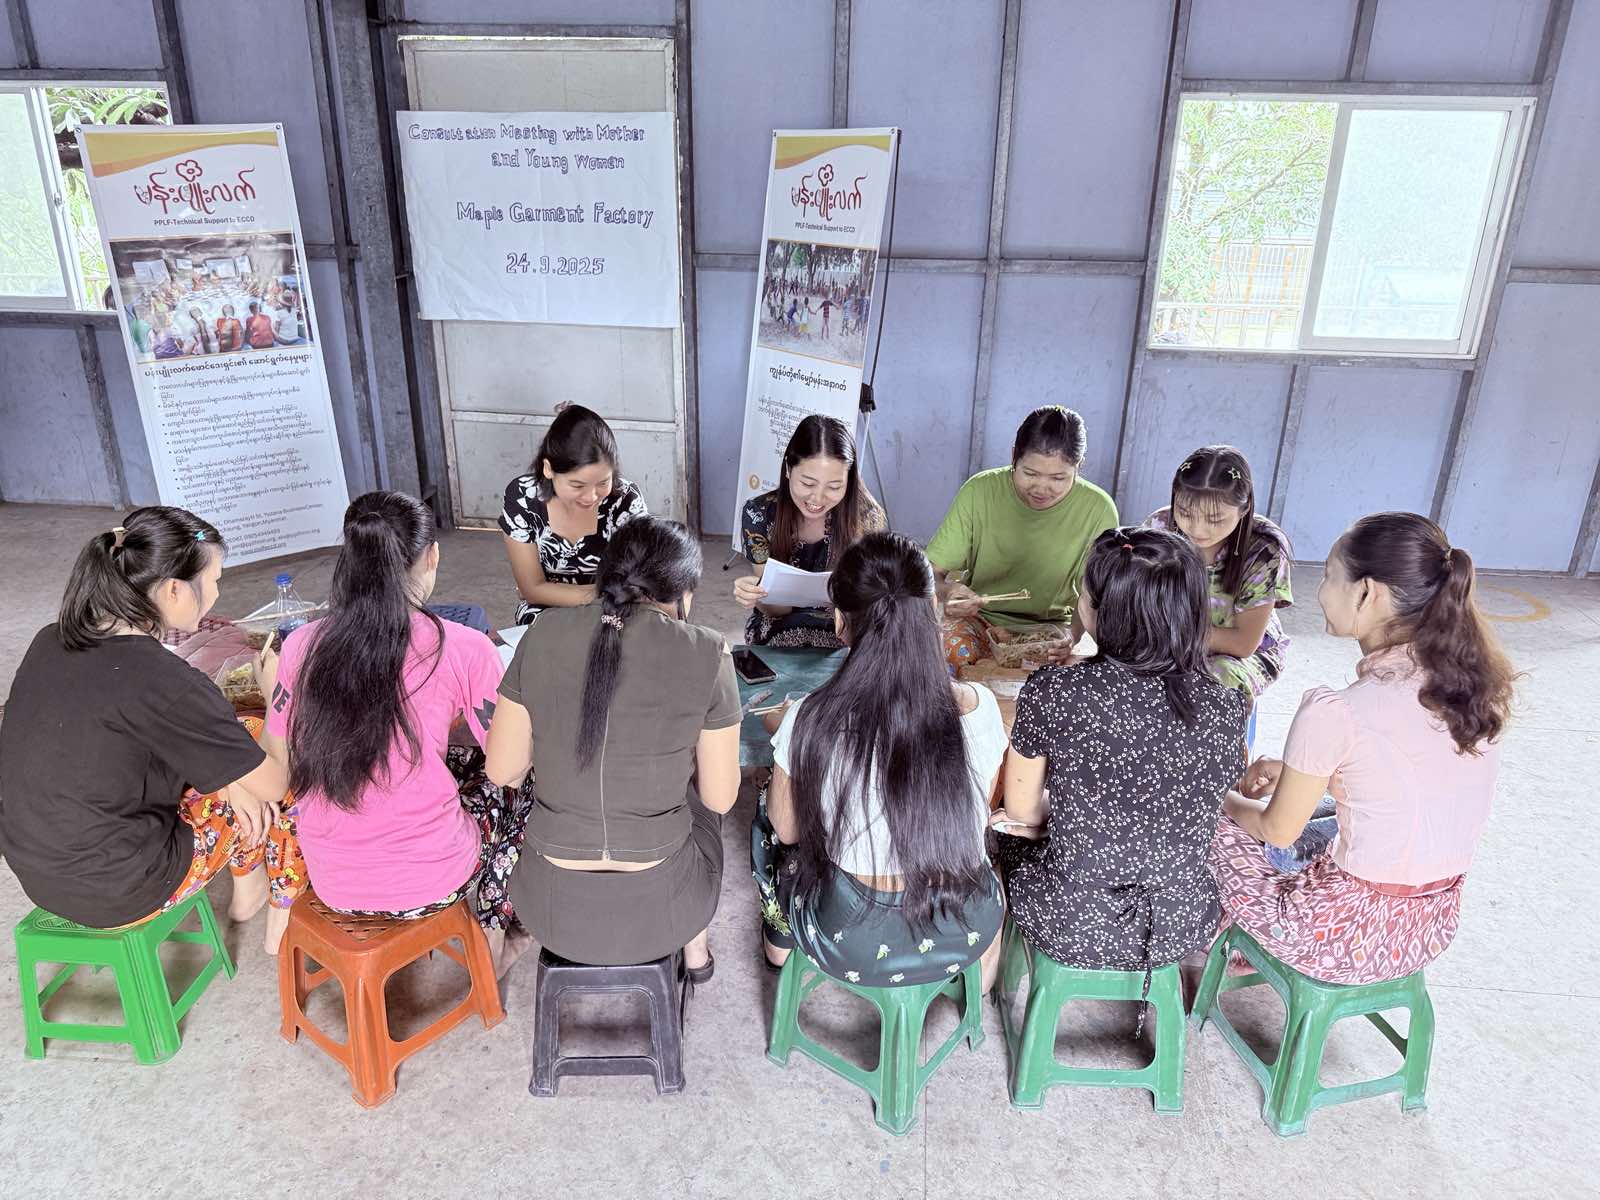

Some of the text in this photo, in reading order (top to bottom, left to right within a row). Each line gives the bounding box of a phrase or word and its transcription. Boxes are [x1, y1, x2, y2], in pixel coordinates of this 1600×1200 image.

[500, 123, 558, 145] Meeting
[563, 124, 593, 141] with
[596, 122, 645, 141] Mother
[491, 148, 625, 175] and Young Women
[203, 217, 229, 225] Support
[456, 201, 654, 230] Maple Garment Factory
[506, 252, 605, 276] 24.9.2025
